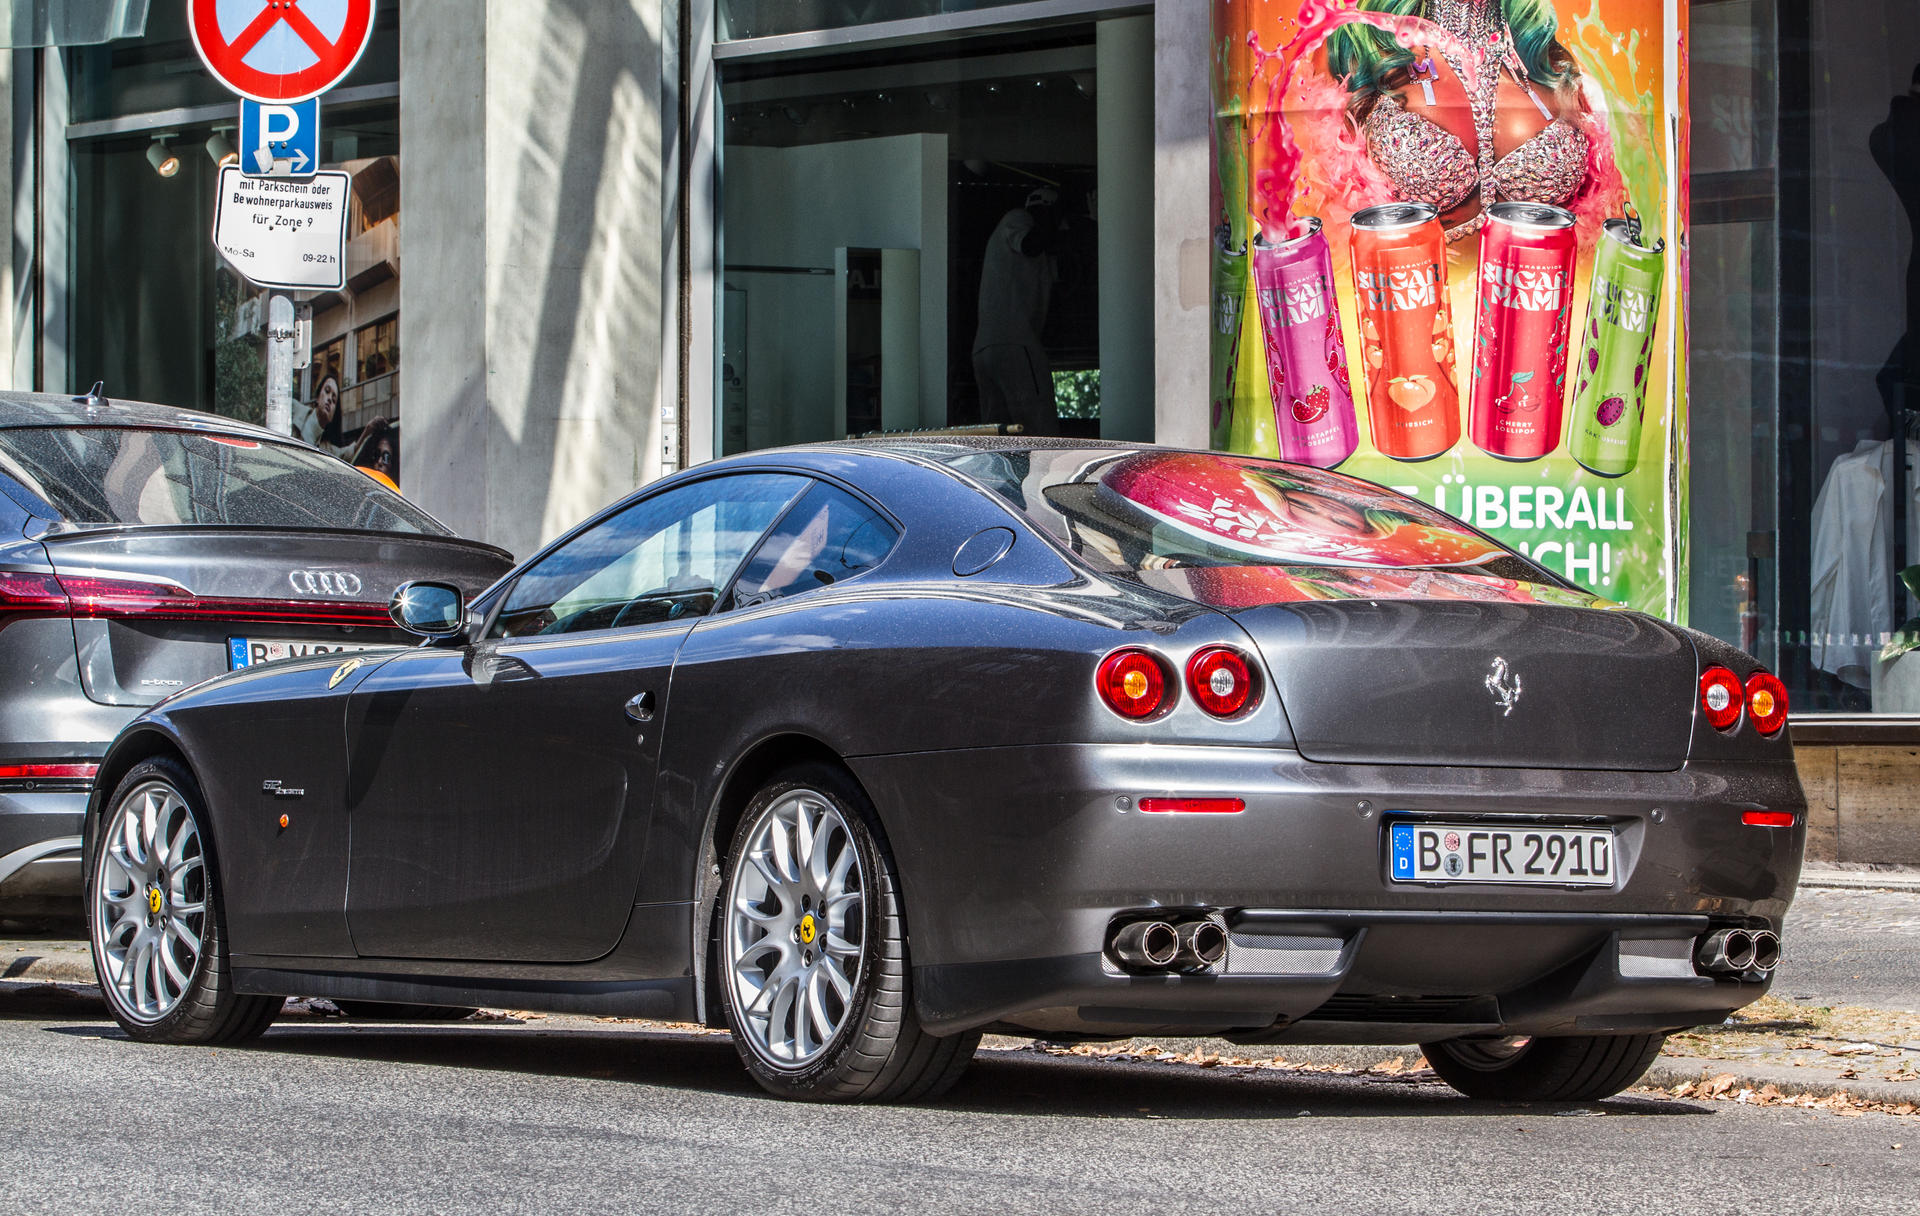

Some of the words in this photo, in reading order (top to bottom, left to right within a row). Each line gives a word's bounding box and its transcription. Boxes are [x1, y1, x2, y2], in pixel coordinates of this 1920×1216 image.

[259, 105, 299, 149] P
[239, 181, 254, 190] mit
[259, 180, 308, 194] Parkschein
[312, 184, 330, 195] oder
[252, 214, 269, 225] für
[275, 215, 302, 227] Zone
[307, 217, 313, 228] 9
[224, 246, 255, 258] Mo-Sa
[302, 253, 327, 263] 09-22
[329, 255, 336, 263] h
[1358, 264, 1440, 290] SUGAR
[1483, 262, 1568, 291] SUGAR
[1368, 286, 1435, 311] MAMI
[1491, 284, 1560, 311] MAMI
[1495, 425, 1535, 434] LOLLIPOP
[1500, 419, 1533, 428] CHERRY
[1435, 473, 1634, 530] ÜBERALL
[1399, 856, 1409, 870] D
[1419, 831, 1441, 872] B
[1467, 832, 1515, 875] FR
[1523, 834, 1609, 877] 2910
